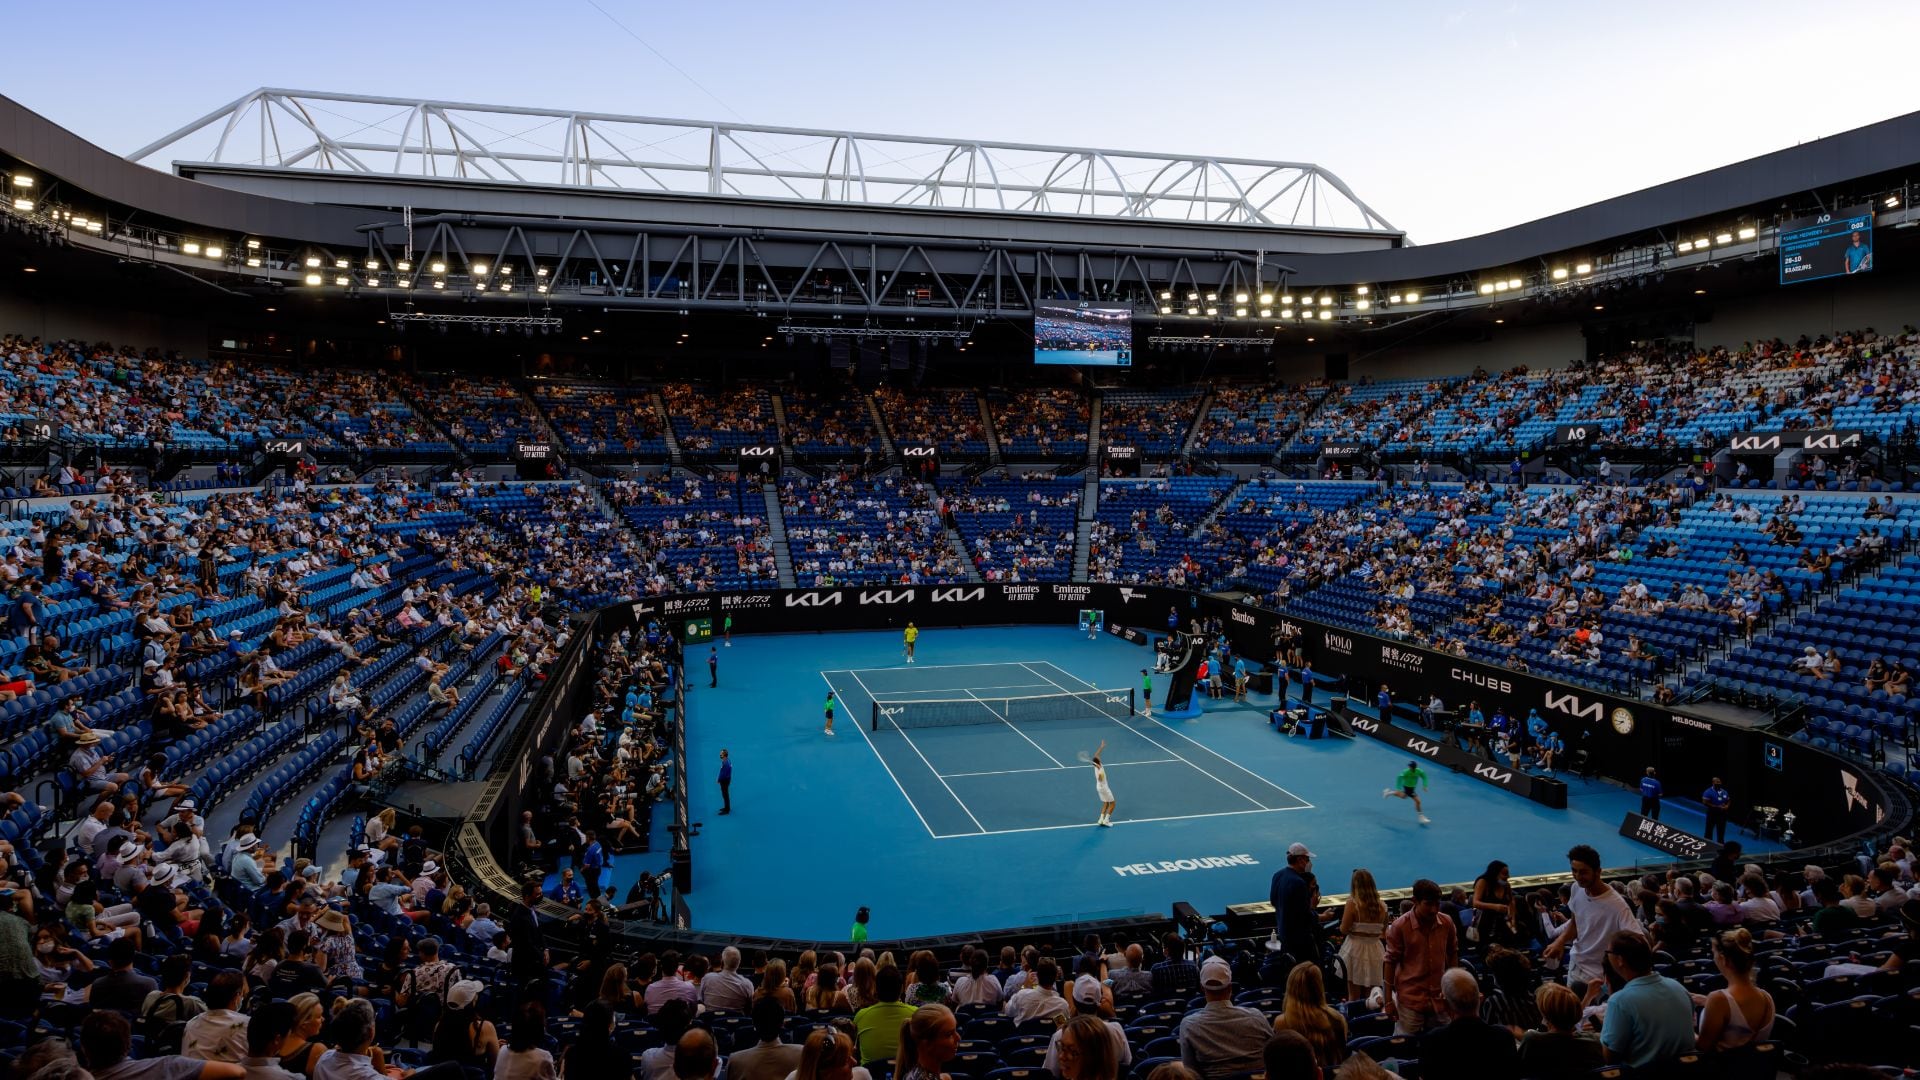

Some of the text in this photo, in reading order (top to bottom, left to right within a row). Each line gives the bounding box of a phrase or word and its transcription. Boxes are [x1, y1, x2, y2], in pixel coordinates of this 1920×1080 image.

[1817, 214, 1831, 224] AO
[1567, 427, 1586, 440] AO
[519, 444, 550, 452] Emirates
[1731, 435, 1780, 450] KIA
[740, 446, 775, 456] KIA
[903, 447, 935, 456] KIA
[860, 589, 915, 605] KIA
[932, 587, 985, 603] KIA
[1003, 585, 1040, 593] Emirates
[1053, 585, 1091, 593] Emirates
[785, 591, 842, 607] KIA
[1231, 607, 1255, 626] Santos
[1192, 637, 1204, 645] AO
[1330, 634, 1352, 650] POLO
[1451, 667, 1512, 694] CHUBB
[1545, 690, 1603, 722] KIA
[1351, 716, 1379, 733] KIA
[1671, 715, 1712, 731] MELBOURNE
[1407, 737, 1439, 756] KIA
[1473, 762, 1512, 784] KIA
[1112, 853, 1260, 877] MELBOURNE
